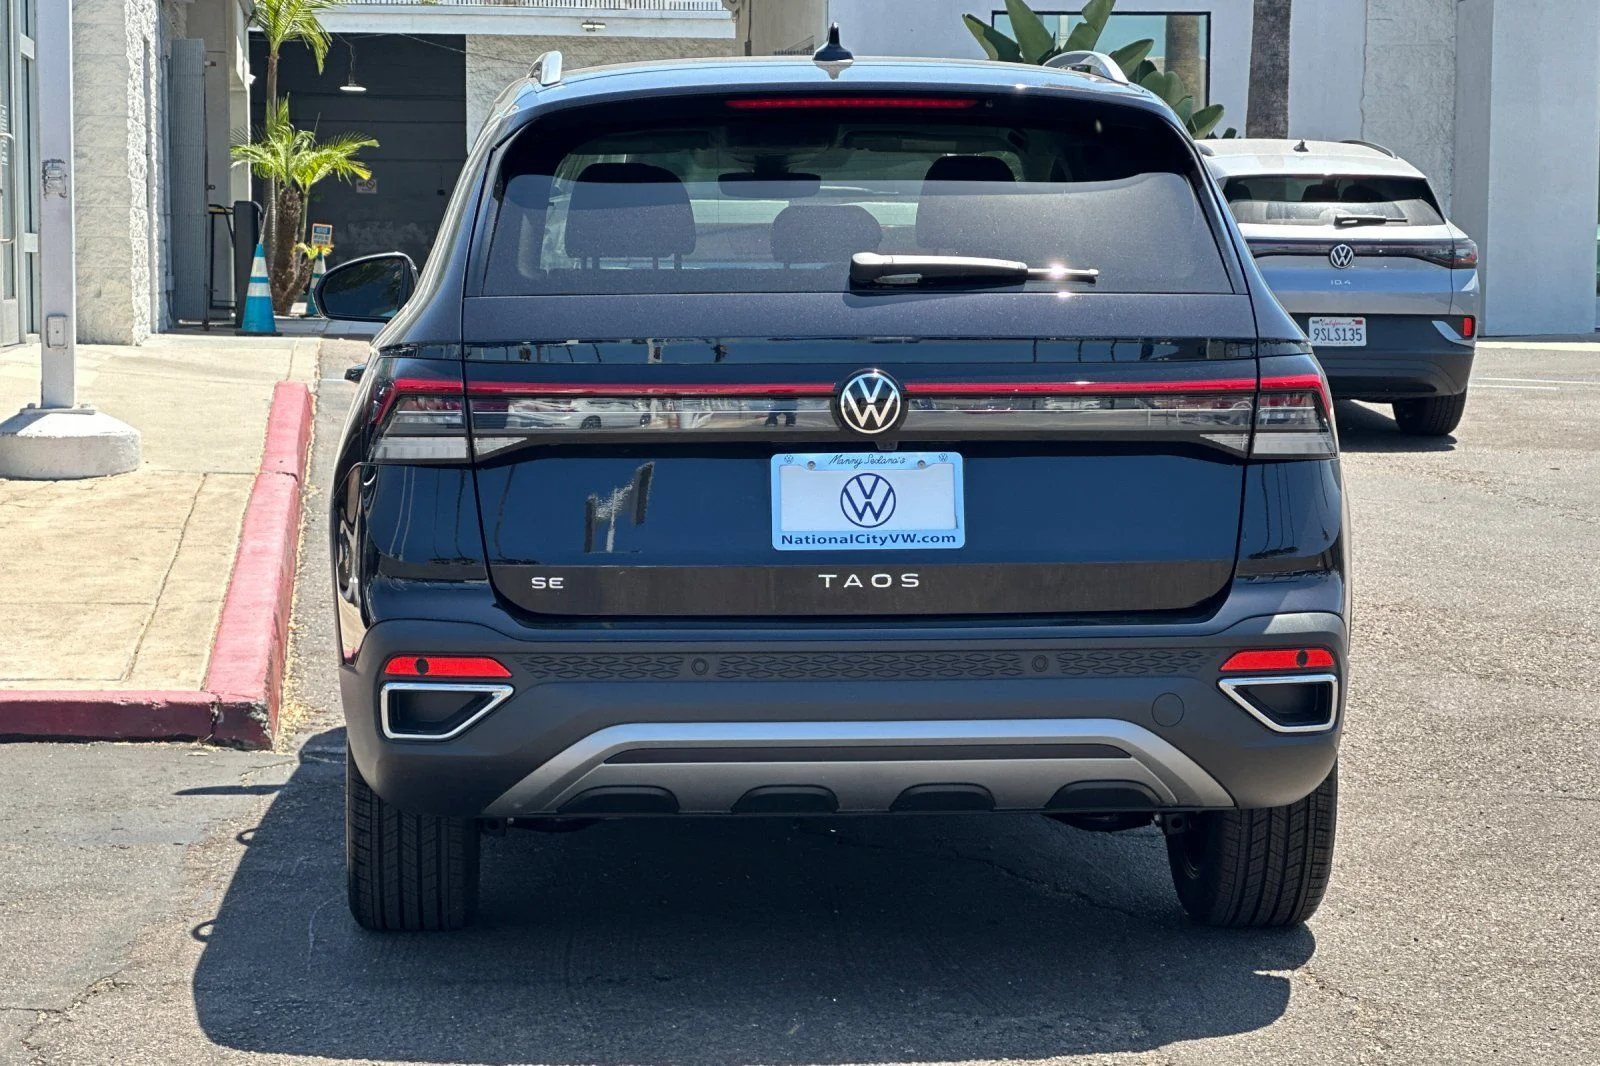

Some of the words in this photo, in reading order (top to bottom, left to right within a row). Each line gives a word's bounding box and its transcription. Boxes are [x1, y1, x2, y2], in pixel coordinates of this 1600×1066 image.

[1330, 244, 1354, 268] VW
[1313, 328, 1363, 342] 9SLS135
[841, 373, 901, 434] VW
[828, 454, 863, 469] Manny
[863, 453, 907, 465] Sedano's
[840, 472, 897, 529] VW
[781, 533, 957, 546] NationalCityVW.com
[531, 576, 564, 589] SE
[818, 573, 920, 588] TAOS
